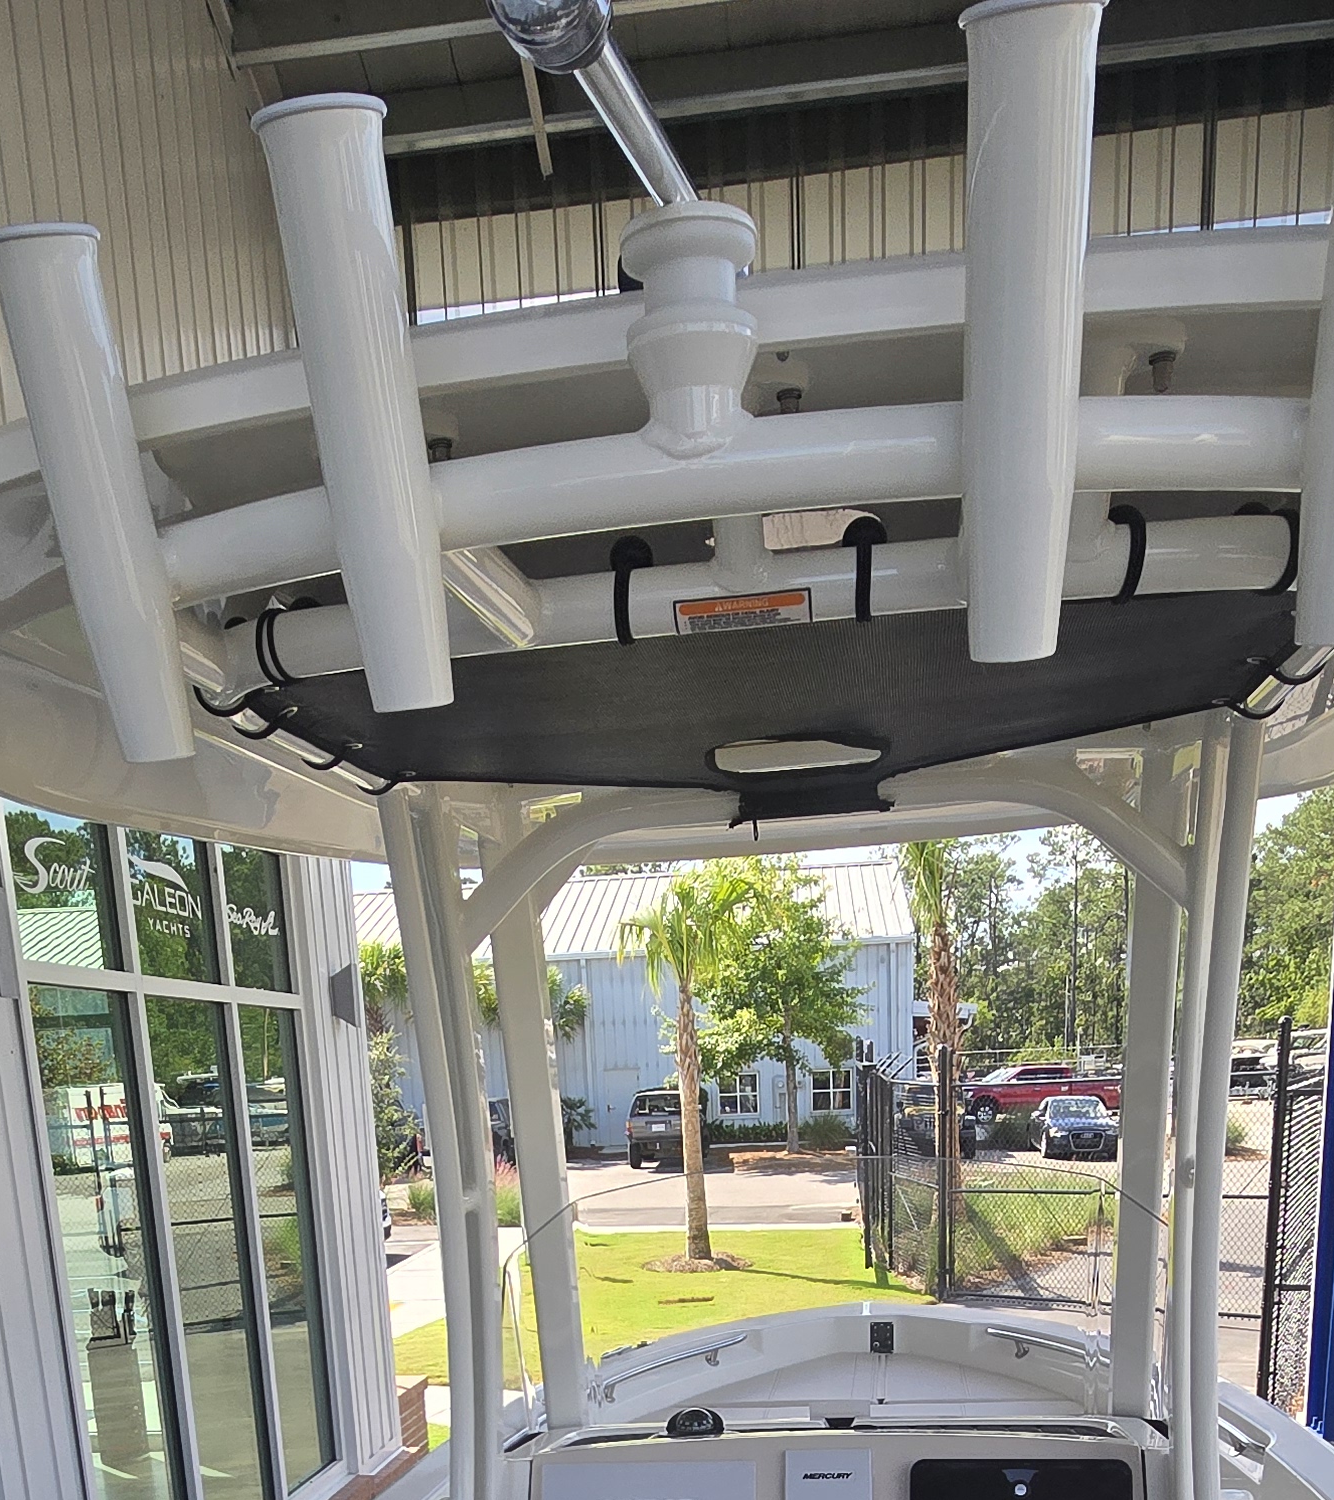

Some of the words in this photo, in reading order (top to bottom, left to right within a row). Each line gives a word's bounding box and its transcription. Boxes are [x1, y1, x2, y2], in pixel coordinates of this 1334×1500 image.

[13, 836, 96, 894] Scout
[147, 917, 192, 938] YACHTS
[802, 1472, 853, 1480] MERCURY
